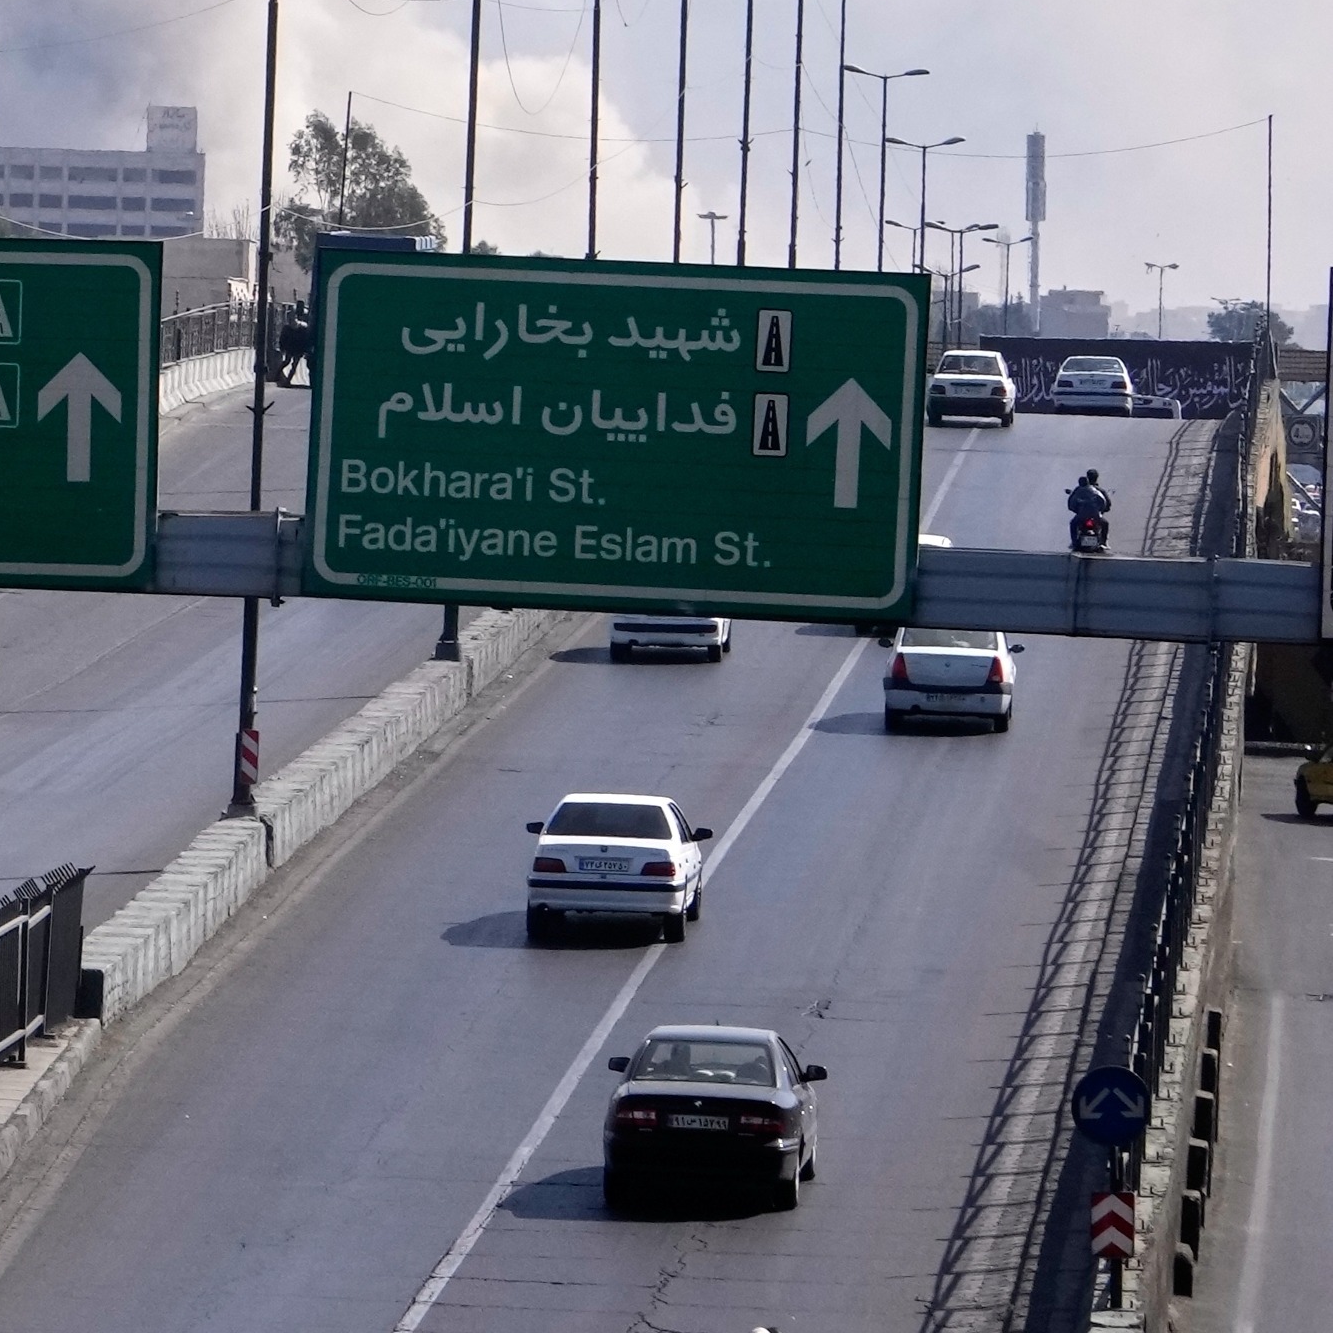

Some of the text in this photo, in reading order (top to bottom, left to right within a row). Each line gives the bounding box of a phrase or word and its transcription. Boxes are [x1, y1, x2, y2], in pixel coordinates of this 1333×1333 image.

[401, 302, 741, 361] شهید بخارایی
[378, 382, 737, 442] فداییان اسلام
[340, 458, 606, 505] Bokhara'i St.
[337, 514, 772, 568] Fada'iyane Eslam St.
